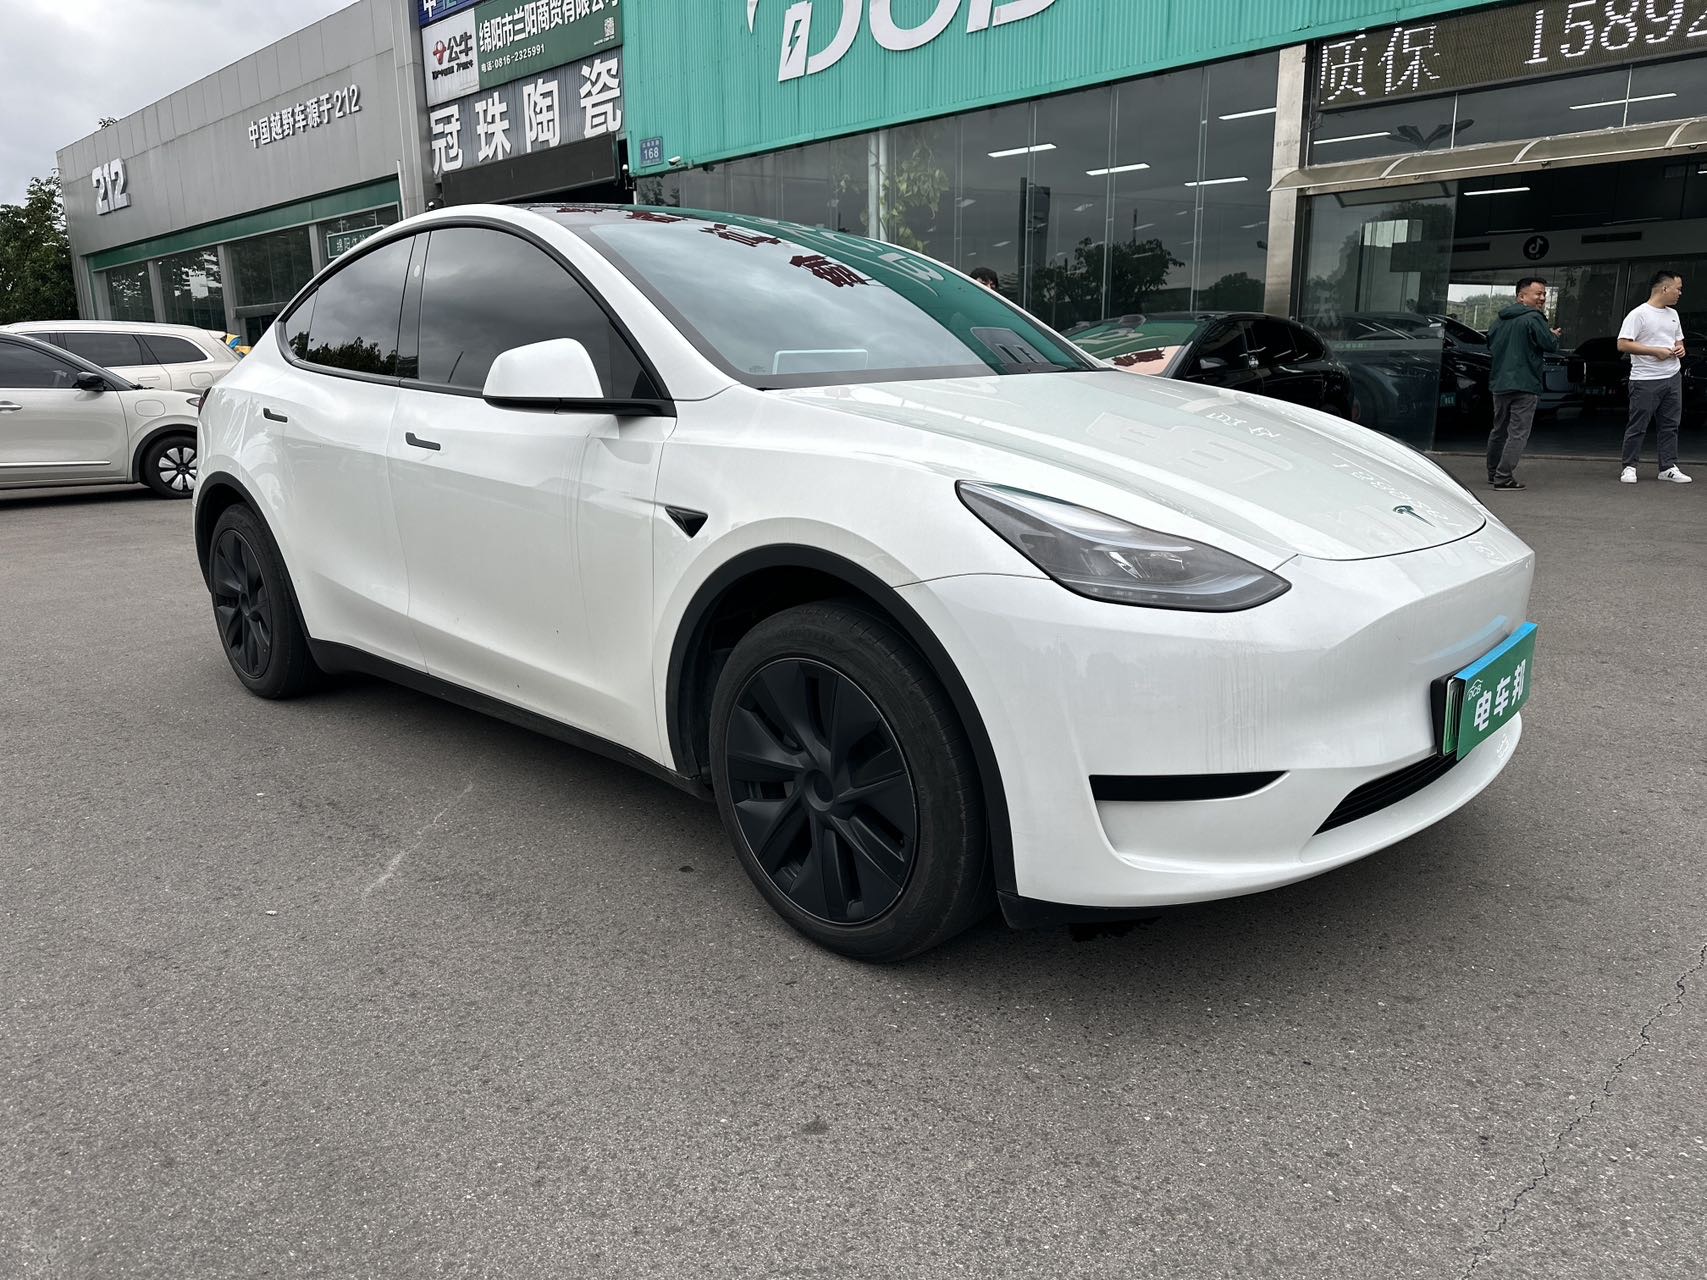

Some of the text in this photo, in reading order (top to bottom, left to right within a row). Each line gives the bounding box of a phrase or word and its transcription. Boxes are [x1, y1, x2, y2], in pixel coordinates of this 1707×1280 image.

[447, 32, 473, 63] 公牛
[478, 0, 619, 53] 绵阳市兰阳商贸有限
[248, 84, 361, 149] 中国越野车源于212
[429, 57, 622, 176] 冠珠陶瓷
[643, 147, 660, 160] 168
[91, 157, 132, 216] 212
